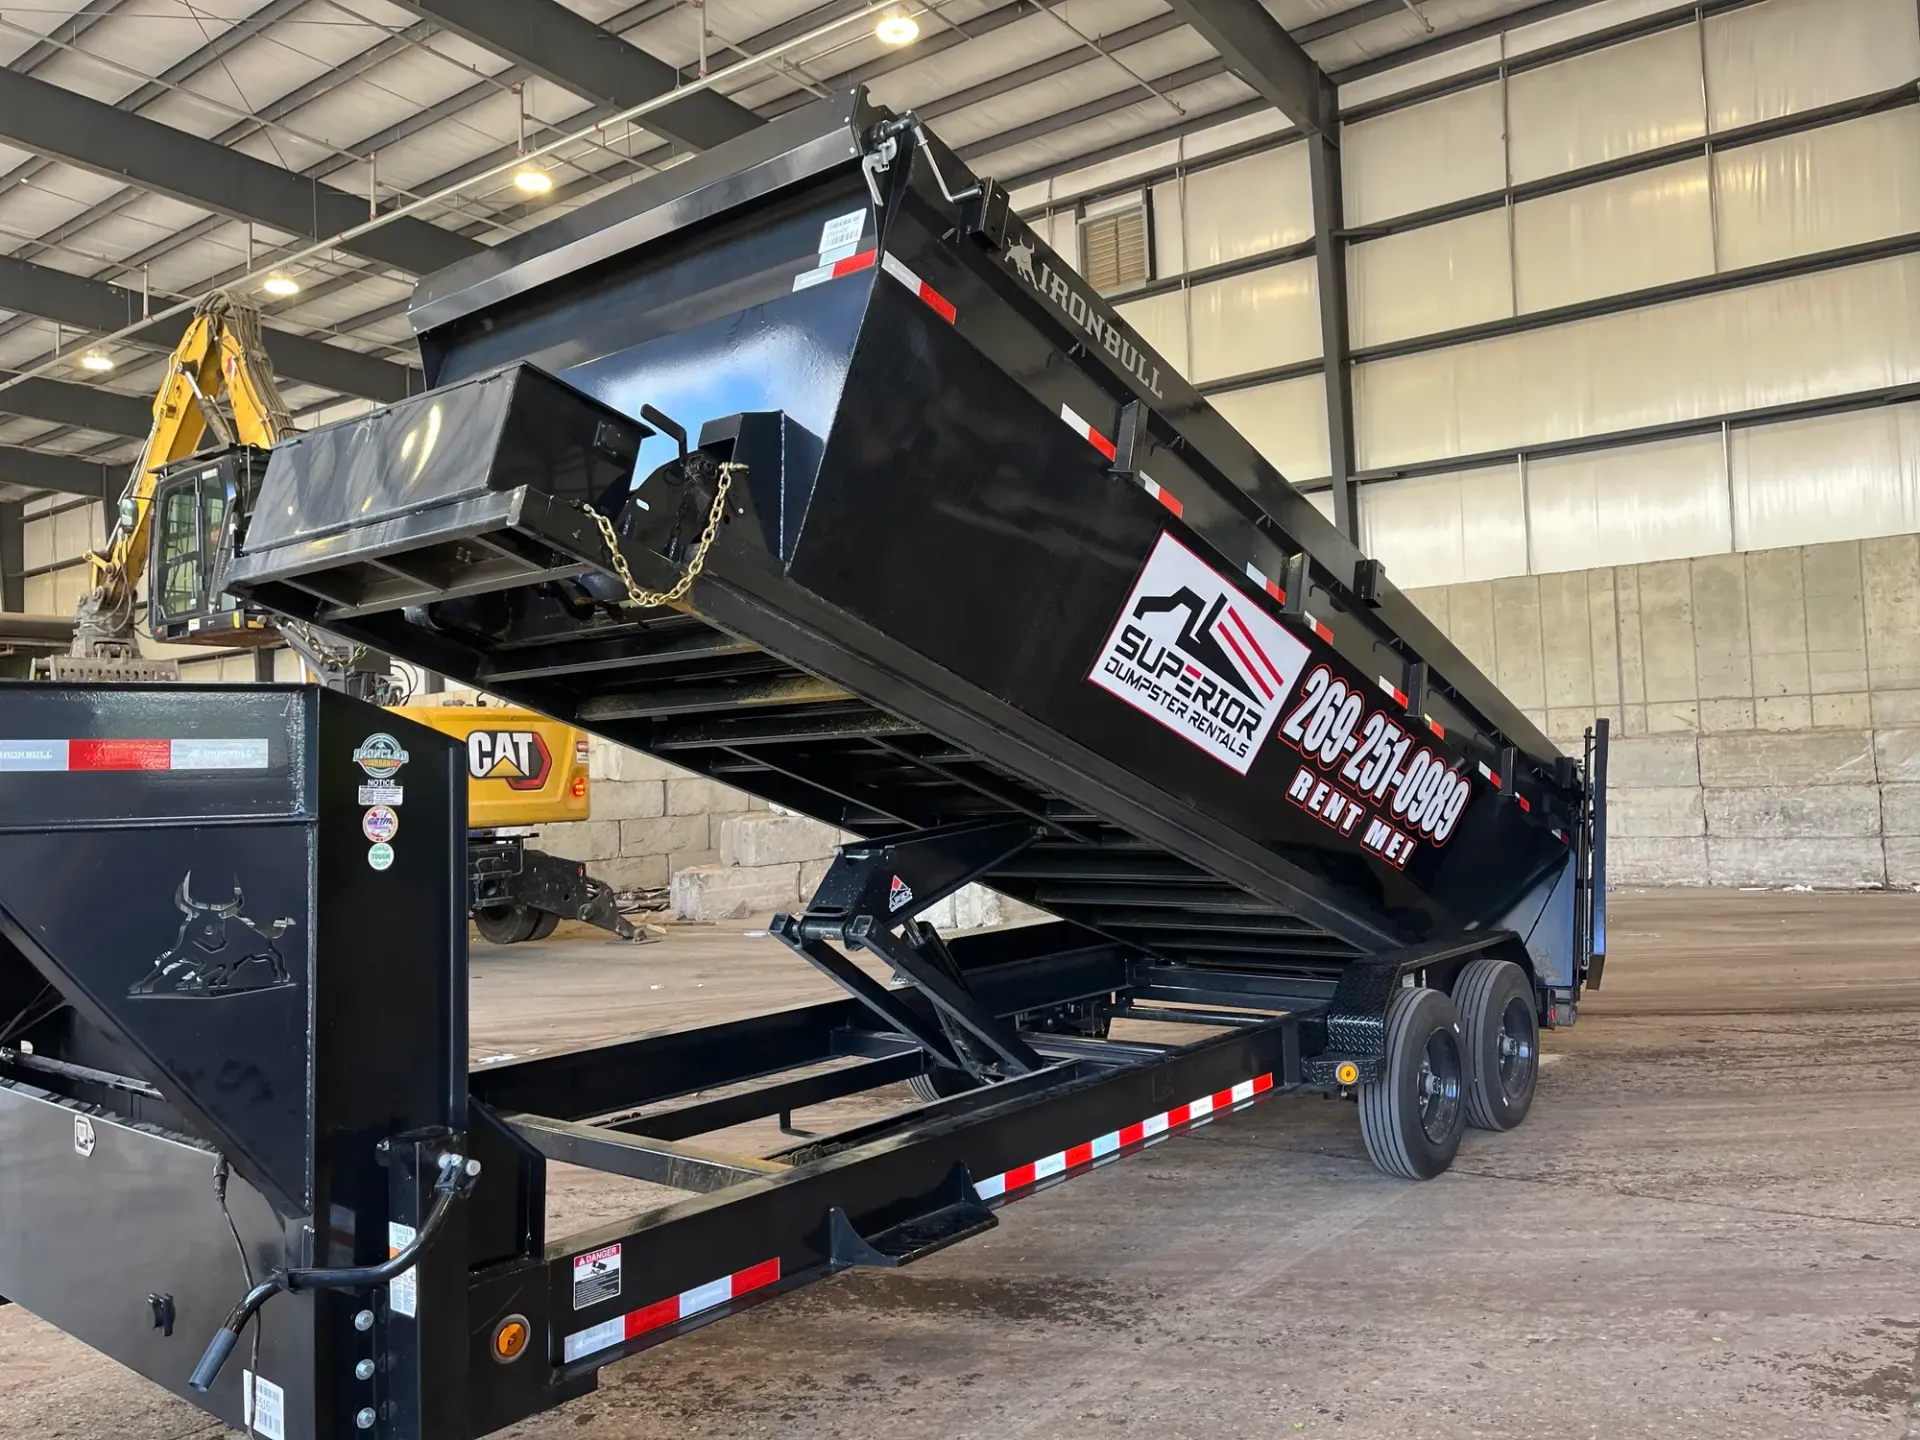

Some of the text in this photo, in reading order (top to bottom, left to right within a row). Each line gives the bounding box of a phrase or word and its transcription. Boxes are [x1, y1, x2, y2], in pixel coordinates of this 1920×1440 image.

[1039, 262, 1163, 400] IRONBULL
[1104, 656, 1249, 758] DUMPSTER RENTALS
[1114, 624, 1262, 742] SUPERIOR
[367, 779, 396, 787] NOTICE
[468, 731, 533, 778] CAT
[1281, 666, 1470, 842] 269-251-0989
[1288, 769, 1415, 865] RENT ME!
[585, 1246, 617, 1263] DANGER
